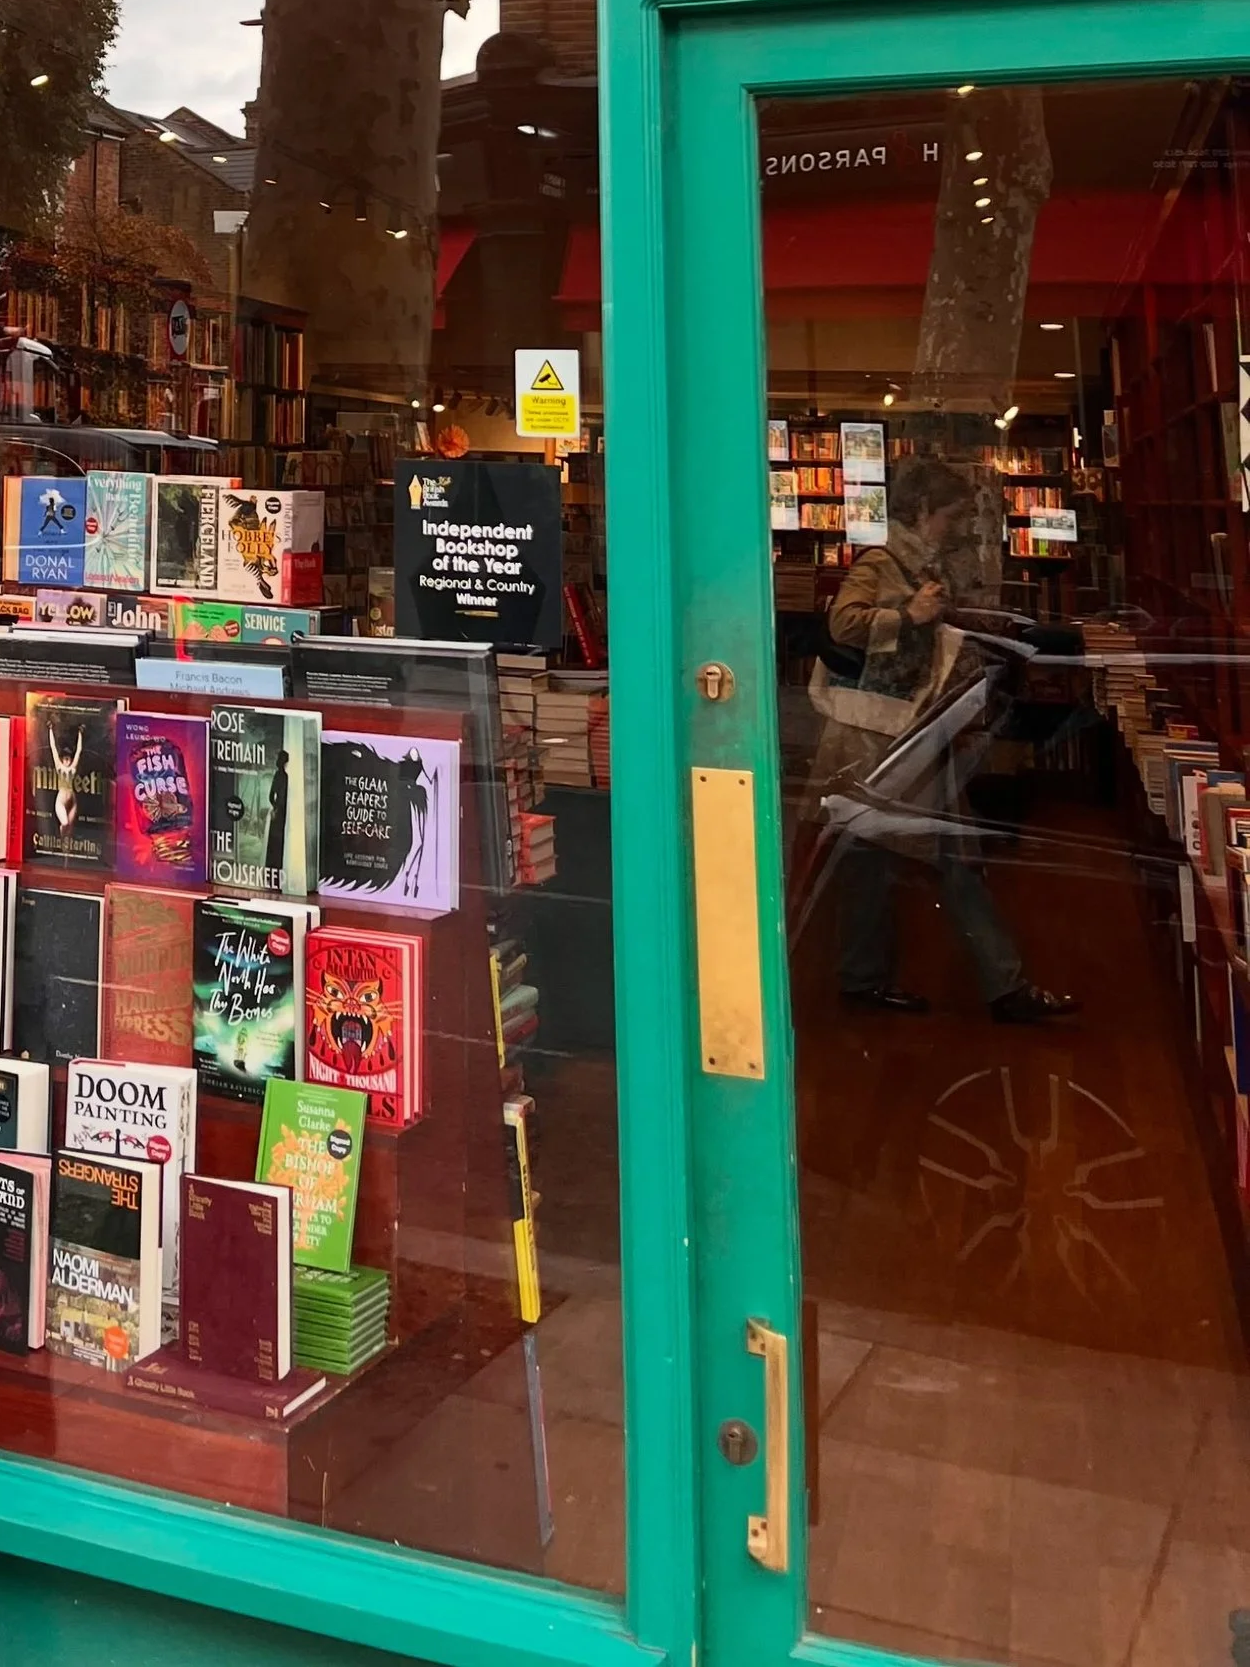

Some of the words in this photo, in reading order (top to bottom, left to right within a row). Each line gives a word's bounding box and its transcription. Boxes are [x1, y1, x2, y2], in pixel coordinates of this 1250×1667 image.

[532, 395, 567, 407] Warning
[422, 519, 534, 541] Independent
[435, 537, 520, 560] Bookshop
[25, 554, 76, 568] DONAL
[432, 555, 450, 571] of
[451, 555, 481, 573] the
[483, 557, 523, 576] Year
[31, 567, 68, 581] RYAN
[419, 575, 472, 591] Regional
[474, 578, 485, 590] &
[486, 578, 536, 596] Country
[455, 593, 499, 607] Winner
[39, 602, 96, 620] YELLOW
[111, 602, 162, 632] John
[244, 613, 287, 632] SERVICE
[175, 670, 210, 683] Francis
[211, 672, 243, 685] Bacon
[210, 709, 246, 734] ROSE
[145, 745, 163, 755] THE
[211, 738, 266, 766] TREMAIN
[136, 754, 176, 775] FISH
[134, 776, 190, 802] CURSE
[344, 776, 358, 786] THE
[358, 776, 389, 793] GLAM
[344, 791, 389, 810] REAPER'S
[346, 806, 375, 823] GUIDE
[376, 810, 388, 821] TO
[341, 820, 392, 840] SELF-CARE
[214, 932, 238, 968] The
[236, 929, 271, 969] White
[326, 948, 377, 970] INTAN
[218, 959, 252, 996] North
[254, 967, 276, 1004] Has
[203, 988, 229, 1017] Thy
[228, 992, 275, 1026] Bones
[308, 1051, 340, 1084] NIGHT
[345, 1069, 398, 1094] THOUSAND
[74, 1072, 168, 1112] DOOM
[73, 1101, 168, 1130] PAINTING
[296, 1100, 336, 1119] Susanna
[298, 1115, 332, 1132] Clarke
[298, 1136, 328, 1155] THE
[284, 1152, 336, 1176] BISHOP
[58, 1158, 139, 1193] STRANGERS
[110, 1186, 140, 1210] THE
[52, 1247, 100, 1279] NAOMI
[51, 1266, 134, 1307] ALDERMAN
